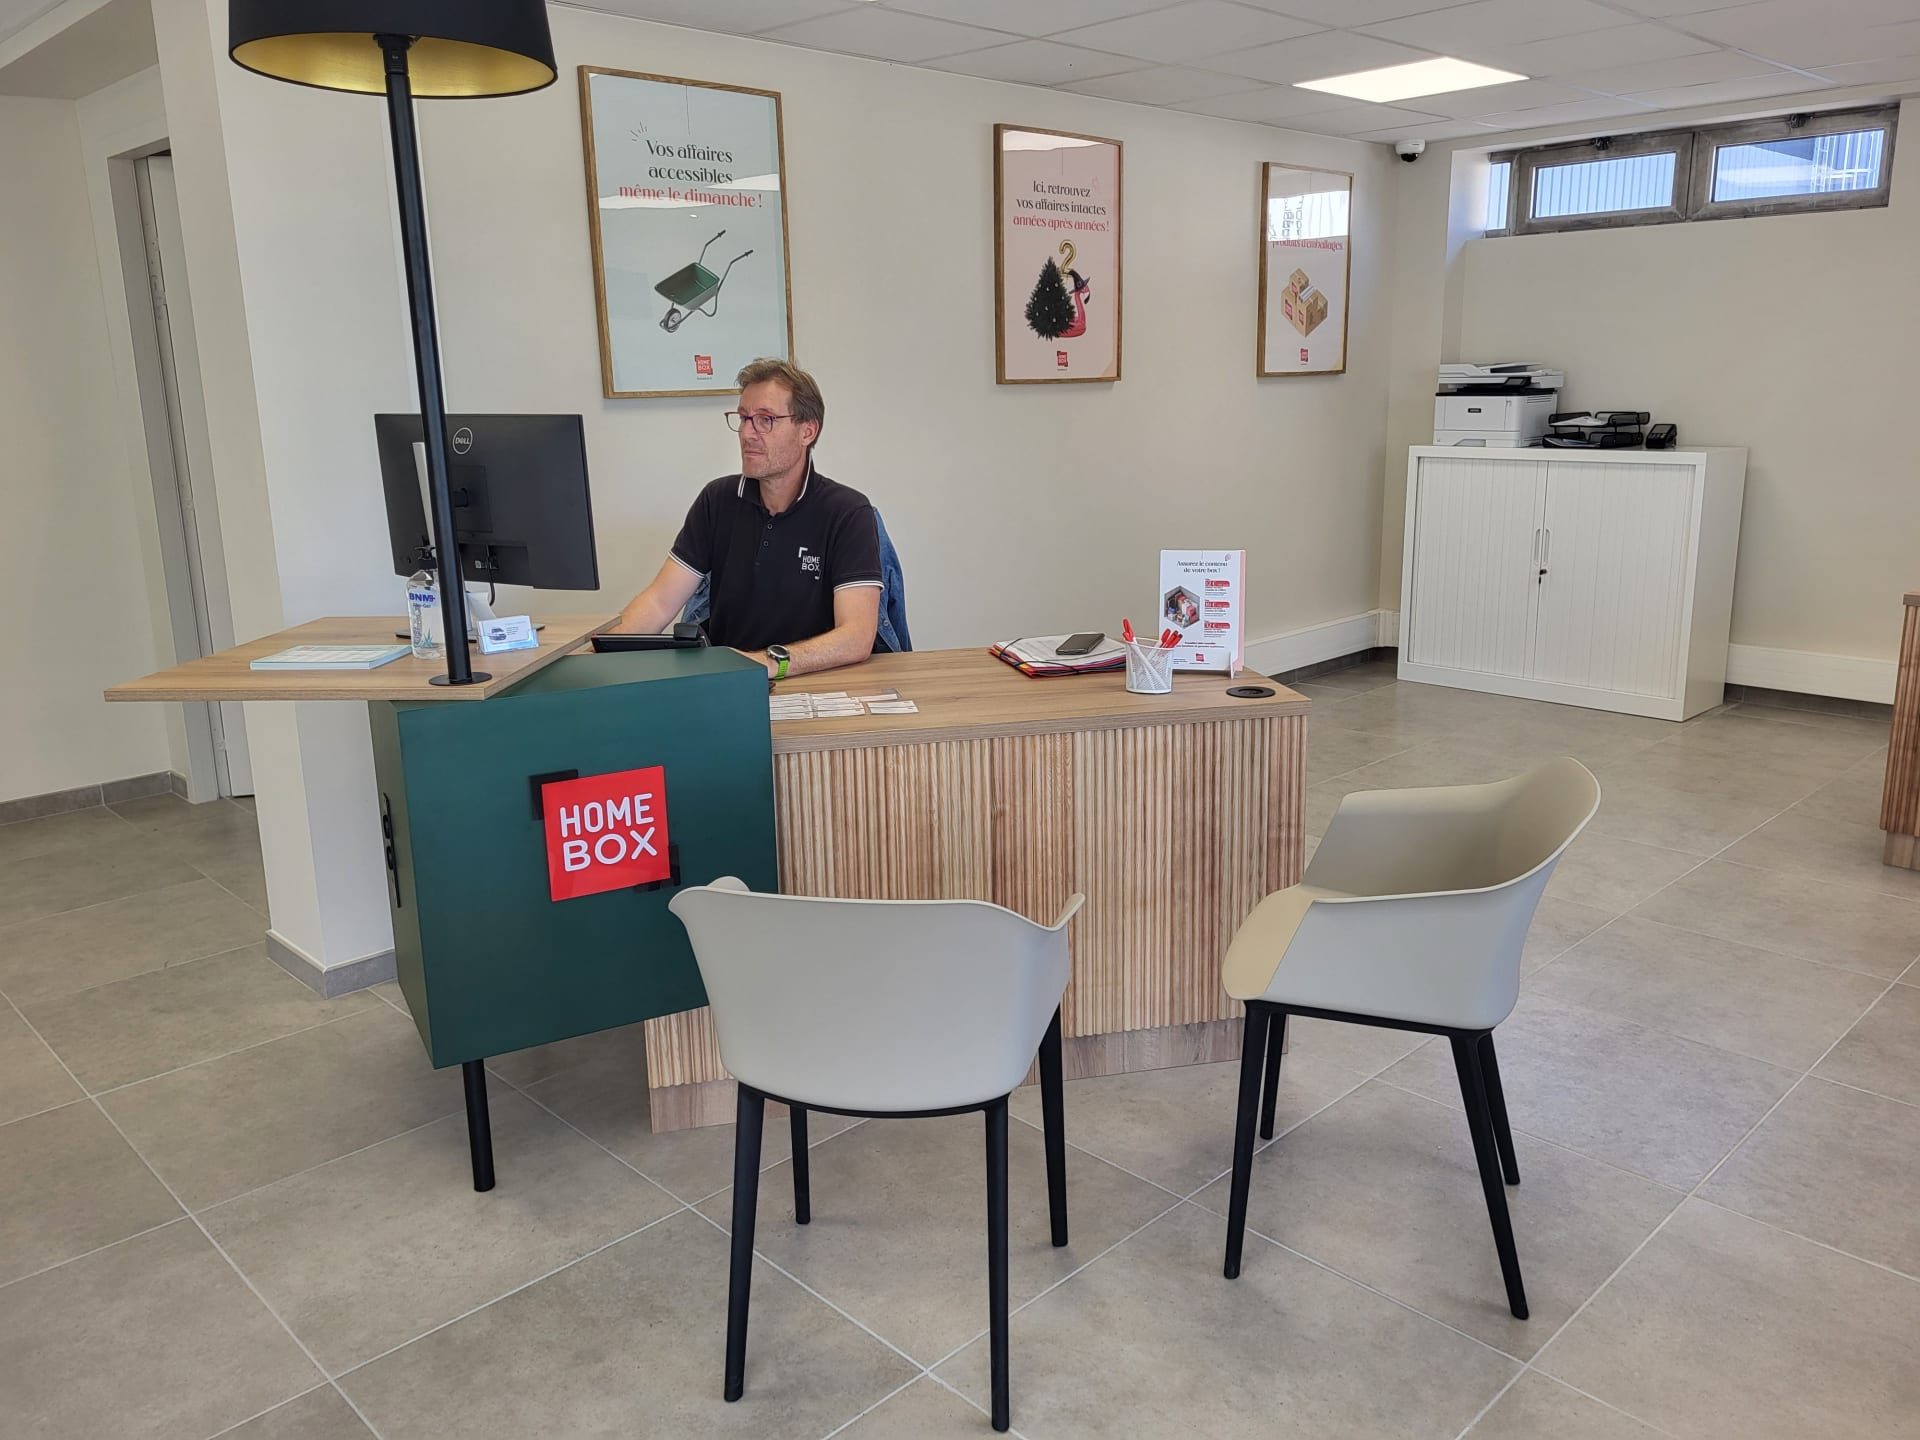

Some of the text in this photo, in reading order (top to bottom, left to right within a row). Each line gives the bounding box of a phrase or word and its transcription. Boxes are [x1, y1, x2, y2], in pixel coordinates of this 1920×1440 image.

[646, 140, 733, 163] Vos affaires
[648, 166, 733, 184] accessibles
[619, 184, 665, 199] même
[668, 187, 680, 200] le
[1033, 180, 1091, 198] Ici, retrouvez
[1035, 199, 1070, 213] affaires
[1071, 201, 1106, 215] intactes
[1013, 215, 1047, 228] années
[1048, 218, 1073, 231] après
[455, 437, 471, 445] DELL
[802, 563, 820, 571] BOX
[803, 555, 820, 563] HOME
[559, 793, 654, 838] HOME
[563, 826, 657, 872] BOX
